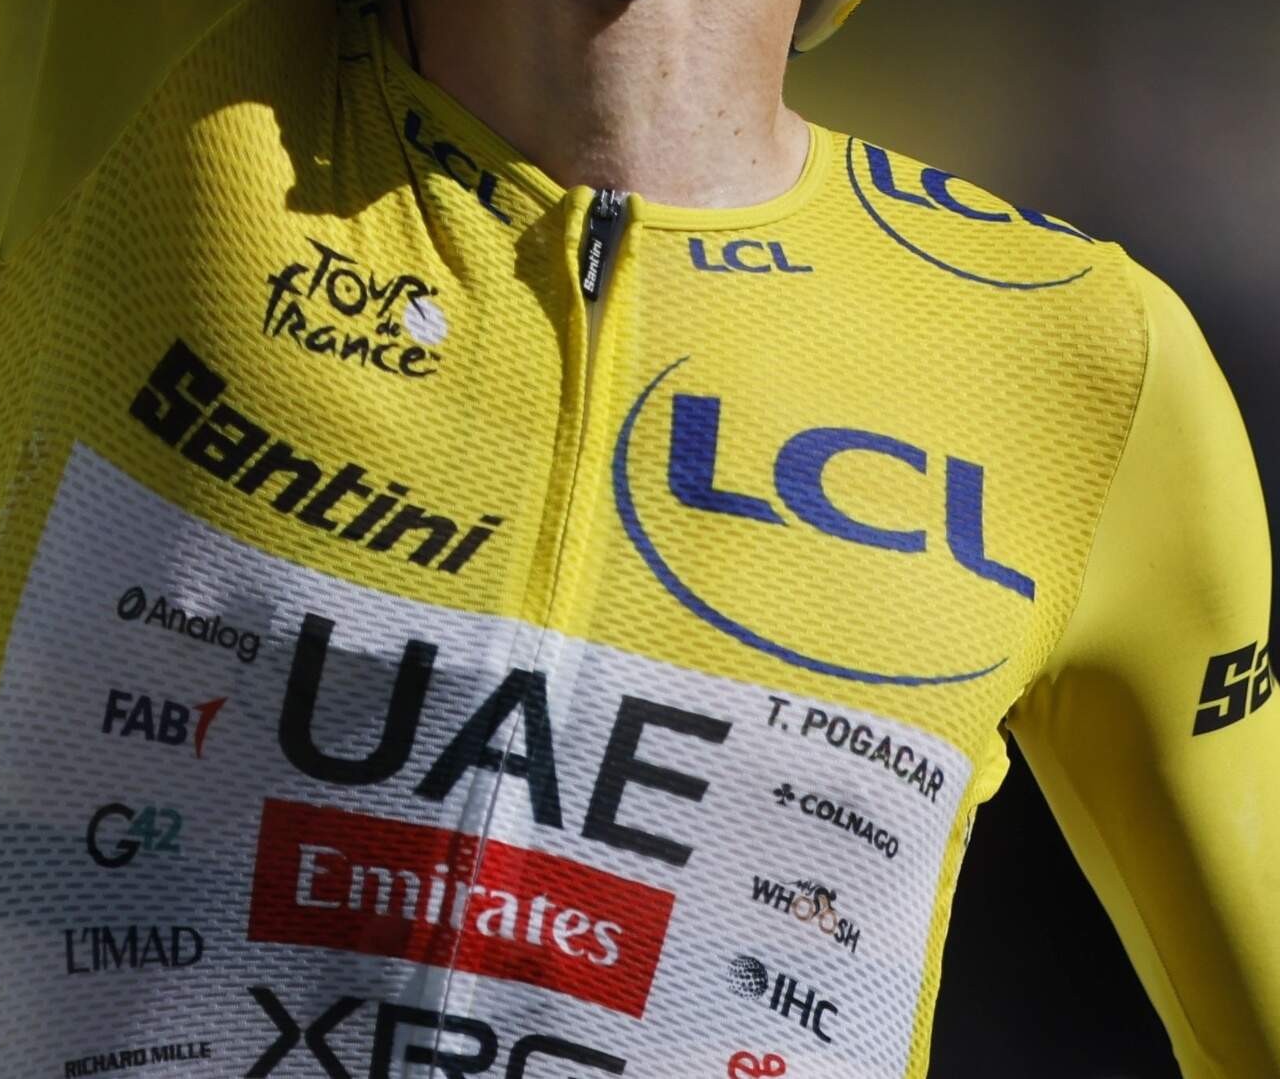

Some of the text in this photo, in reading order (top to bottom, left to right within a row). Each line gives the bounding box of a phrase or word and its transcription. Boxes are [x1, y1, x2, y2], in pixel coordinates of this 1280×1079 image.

[404, 108, 512, 225] LCL
[583, 238, 603, 293] Santini
[688, 237, 812, 274] LCL
[375, 314, 402, 339] de
[128, 338, 503, 575] Santini
[667, 394, 1036, 603] LCL
[144, 594, 261, 664] Analog
[277, 613, 732, 868] UAE
[768, 695, 945, 804] T. POGACAR
[85, 802, 183, 868] G42
[799, 793, 899, 859] COLNAGO
[295, 844, 624, 968] Emirates
[65, 925, 204, 975] L'IMAD
[770, 973, 839, 1045] IHC
[64, 1041, 212, 1079] RICHARD MILLE
